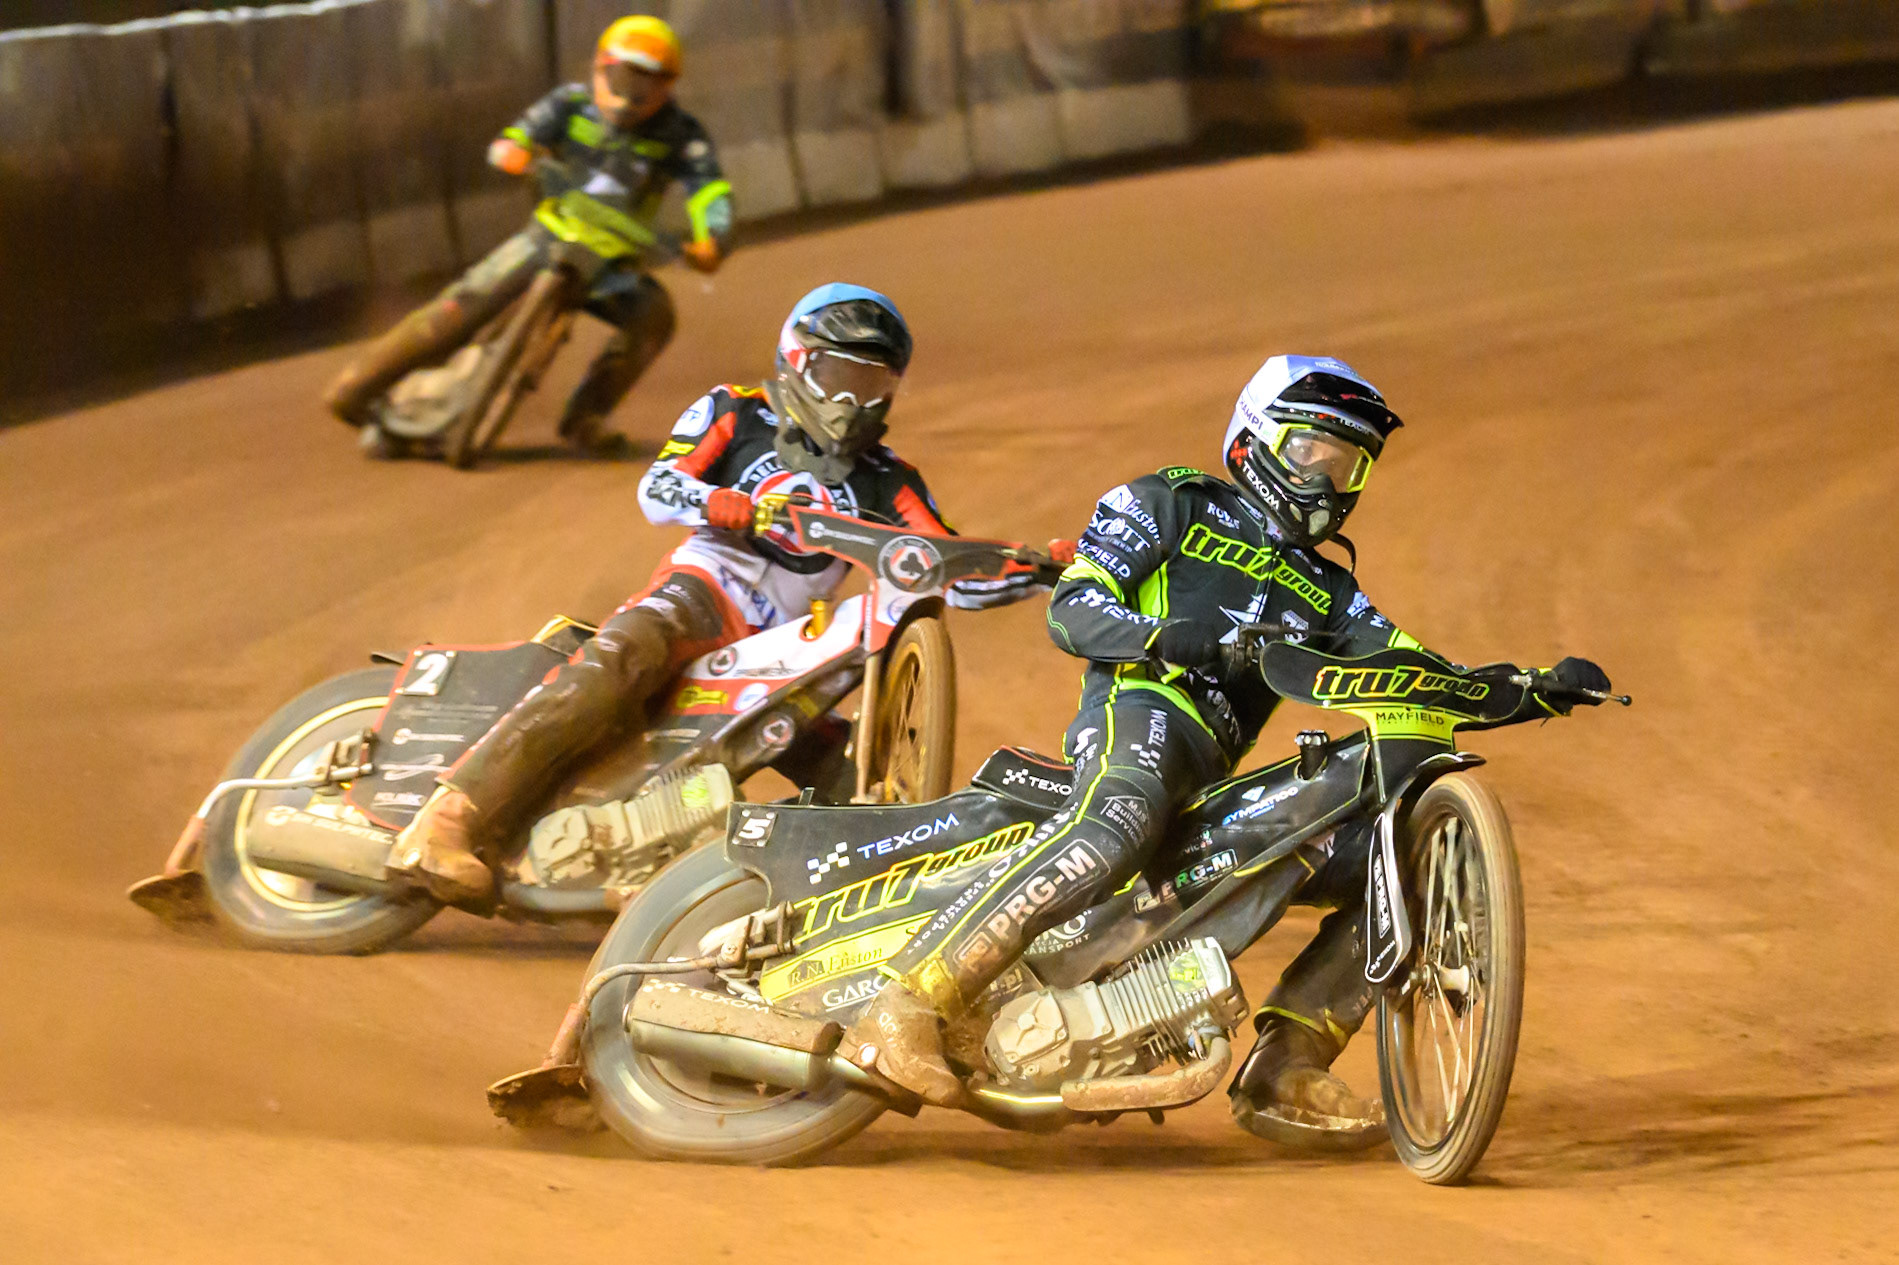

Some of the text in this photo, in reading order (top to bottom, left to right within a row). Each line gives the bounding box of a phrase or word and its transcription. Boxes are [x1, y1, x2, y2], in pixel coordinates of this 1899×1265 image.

[1242, 461, 1281, 510] TEXOM
[404, 653, 449, 695] 2
[1148, 708, 1168, 748] TEXOM
[1376, 711, 1445, 726] MAYFIELD
[1029, 775, 1073, 796] TEXO
[1127, 799, 1148, 824] MJS
[739, 818, 771, 840] 5
[856, 812, 961, 860] TEXOM
[987, 845, 1097, 939] PRG-M
[1024, 932, 1091, 957] ANSPORT
[688, 988, 770, 1015] TEXOM
